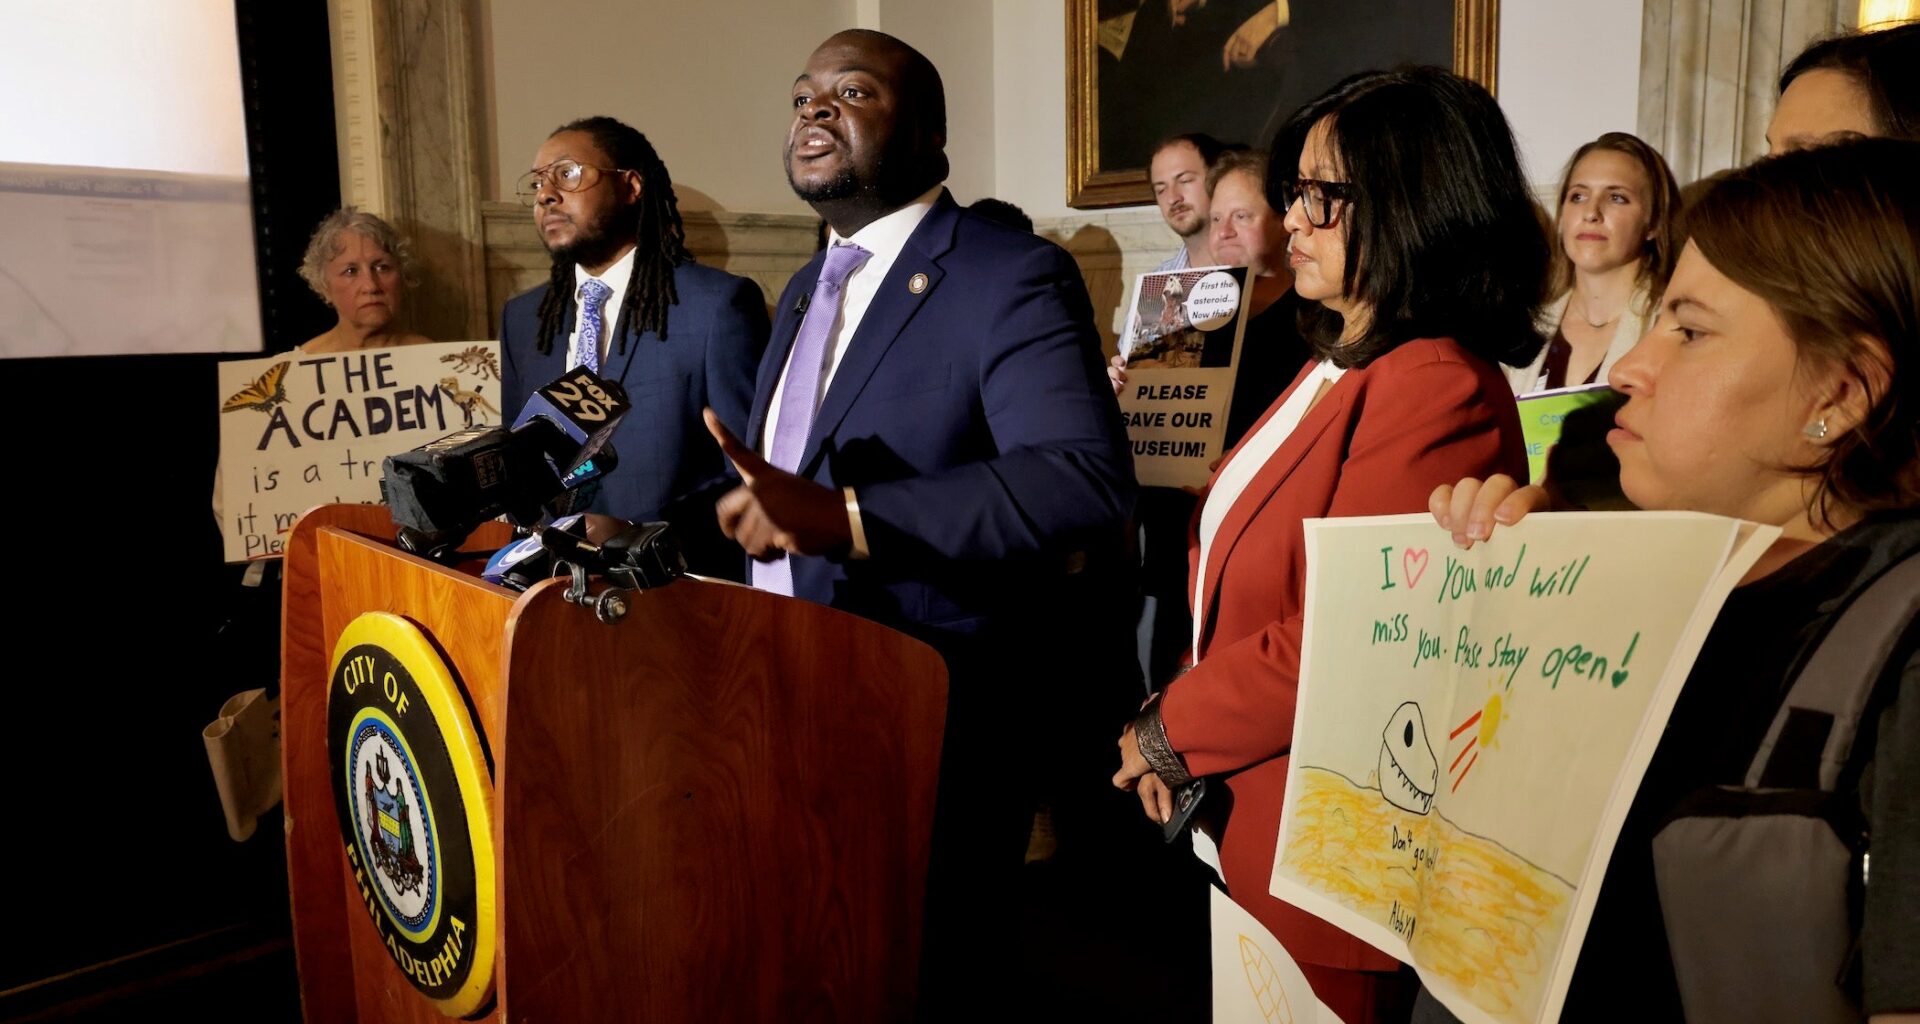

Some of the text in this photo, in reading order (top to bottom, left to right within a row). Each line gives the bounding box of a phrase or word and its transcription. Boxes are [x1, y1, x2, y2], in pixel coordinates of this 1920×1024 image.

[1193, 293, 1234, 305] asteroid...
[1201, 280, 1234, 291] First the
[1192, 308, 1234, 319] Now this?
[299, 352, 398, 395] THE
[547, 381, 607, 422] 29
[574, 374, 620, 412] FOX
[1136, 384, 1209, 400] PLEASE
[1121, 411, 1213, 429] SAVE OUR
[1129, 440, 1207, 458] USEUM!
[253, 466, 280, 493] is
[303, 463, 321, 484] a
[237, 502, 257, 535] it
[1381, 546, 1396, 591] I
[1485, 543, 1527, 591] and
[1372, 613, 1409, 646] miss
[344, 655, 409, 716] CITY OF
[1412, 847, 1425, 871] go
[346, 842, 466, 988] PHILADELPHIA
